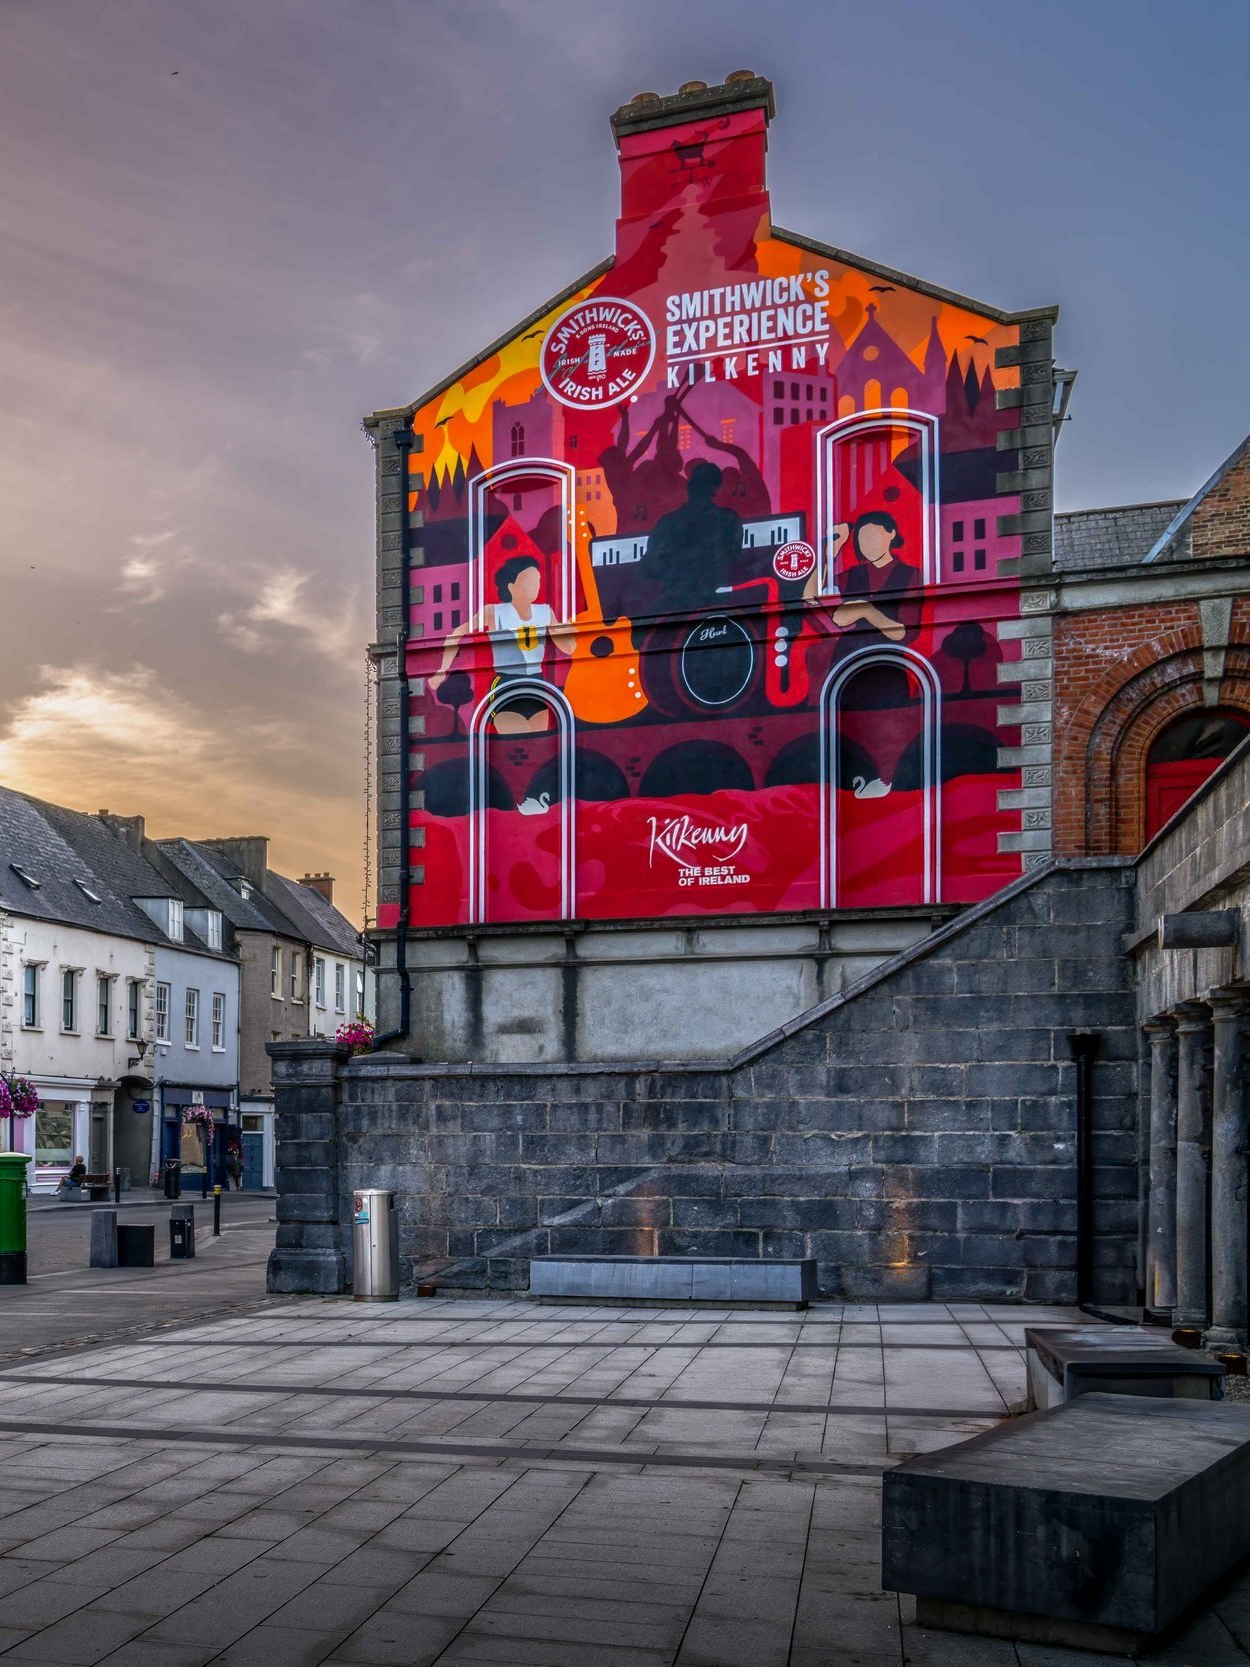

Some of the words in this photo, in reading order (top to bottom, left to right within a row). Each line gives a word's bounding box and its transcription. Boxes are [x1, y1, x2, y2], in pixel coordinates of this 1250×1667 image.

[666, 269, 830, 323] SMITHWICK'S
[596, 323, 619, 333] IRELAND
[666, 300, 830, 355] EXPERIENCE
[613, 348, 637, 357] MADE
[558, 357, 581, 366] IRISH
[667, 342, 830, 389] KILKENNY
[558, 378, 603, 401] IRISH
[608, 368, 636, 396] ALE
[797, 566, 809, 576] ALE
[646, 814, 748, 869] Kilkenny
[678, 868, 701, 877] THE
[705, 866, 735, 876] BEST
[678, 877, 695, 887] OF
[699, 874, 750, 886] IRELAND
